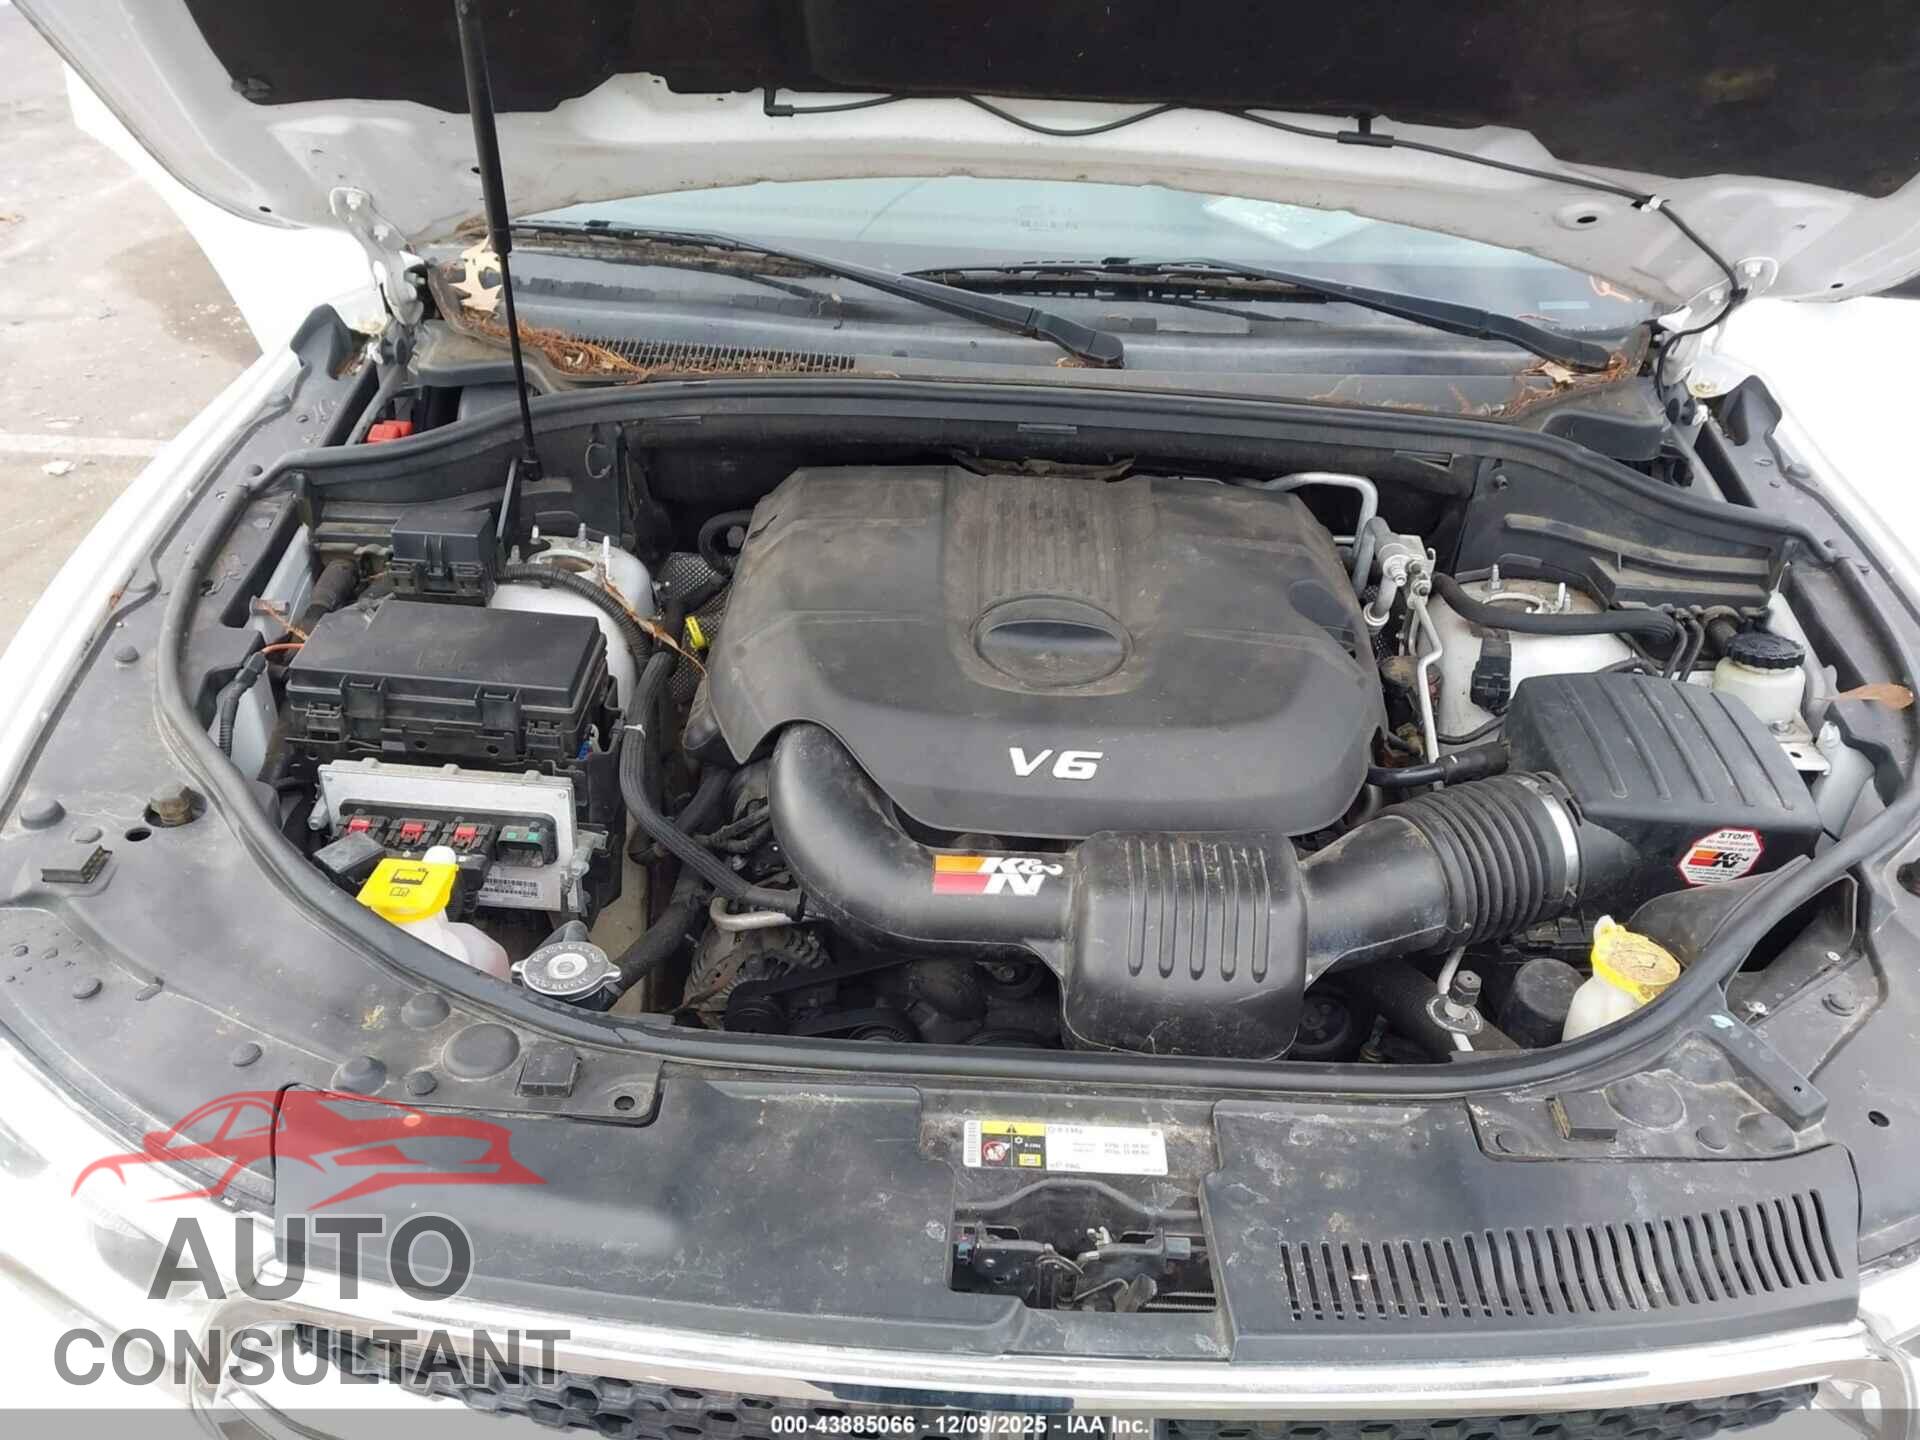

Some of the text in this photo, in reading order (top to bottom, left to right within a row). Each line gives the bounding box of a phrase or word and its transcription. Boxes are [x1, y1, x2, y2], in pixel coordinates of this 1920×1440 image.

[1008, 747, 1104, 780] V6
[1719, 832, 1752, 840] STOP!
[977, 856, 1064, 896] K&N
